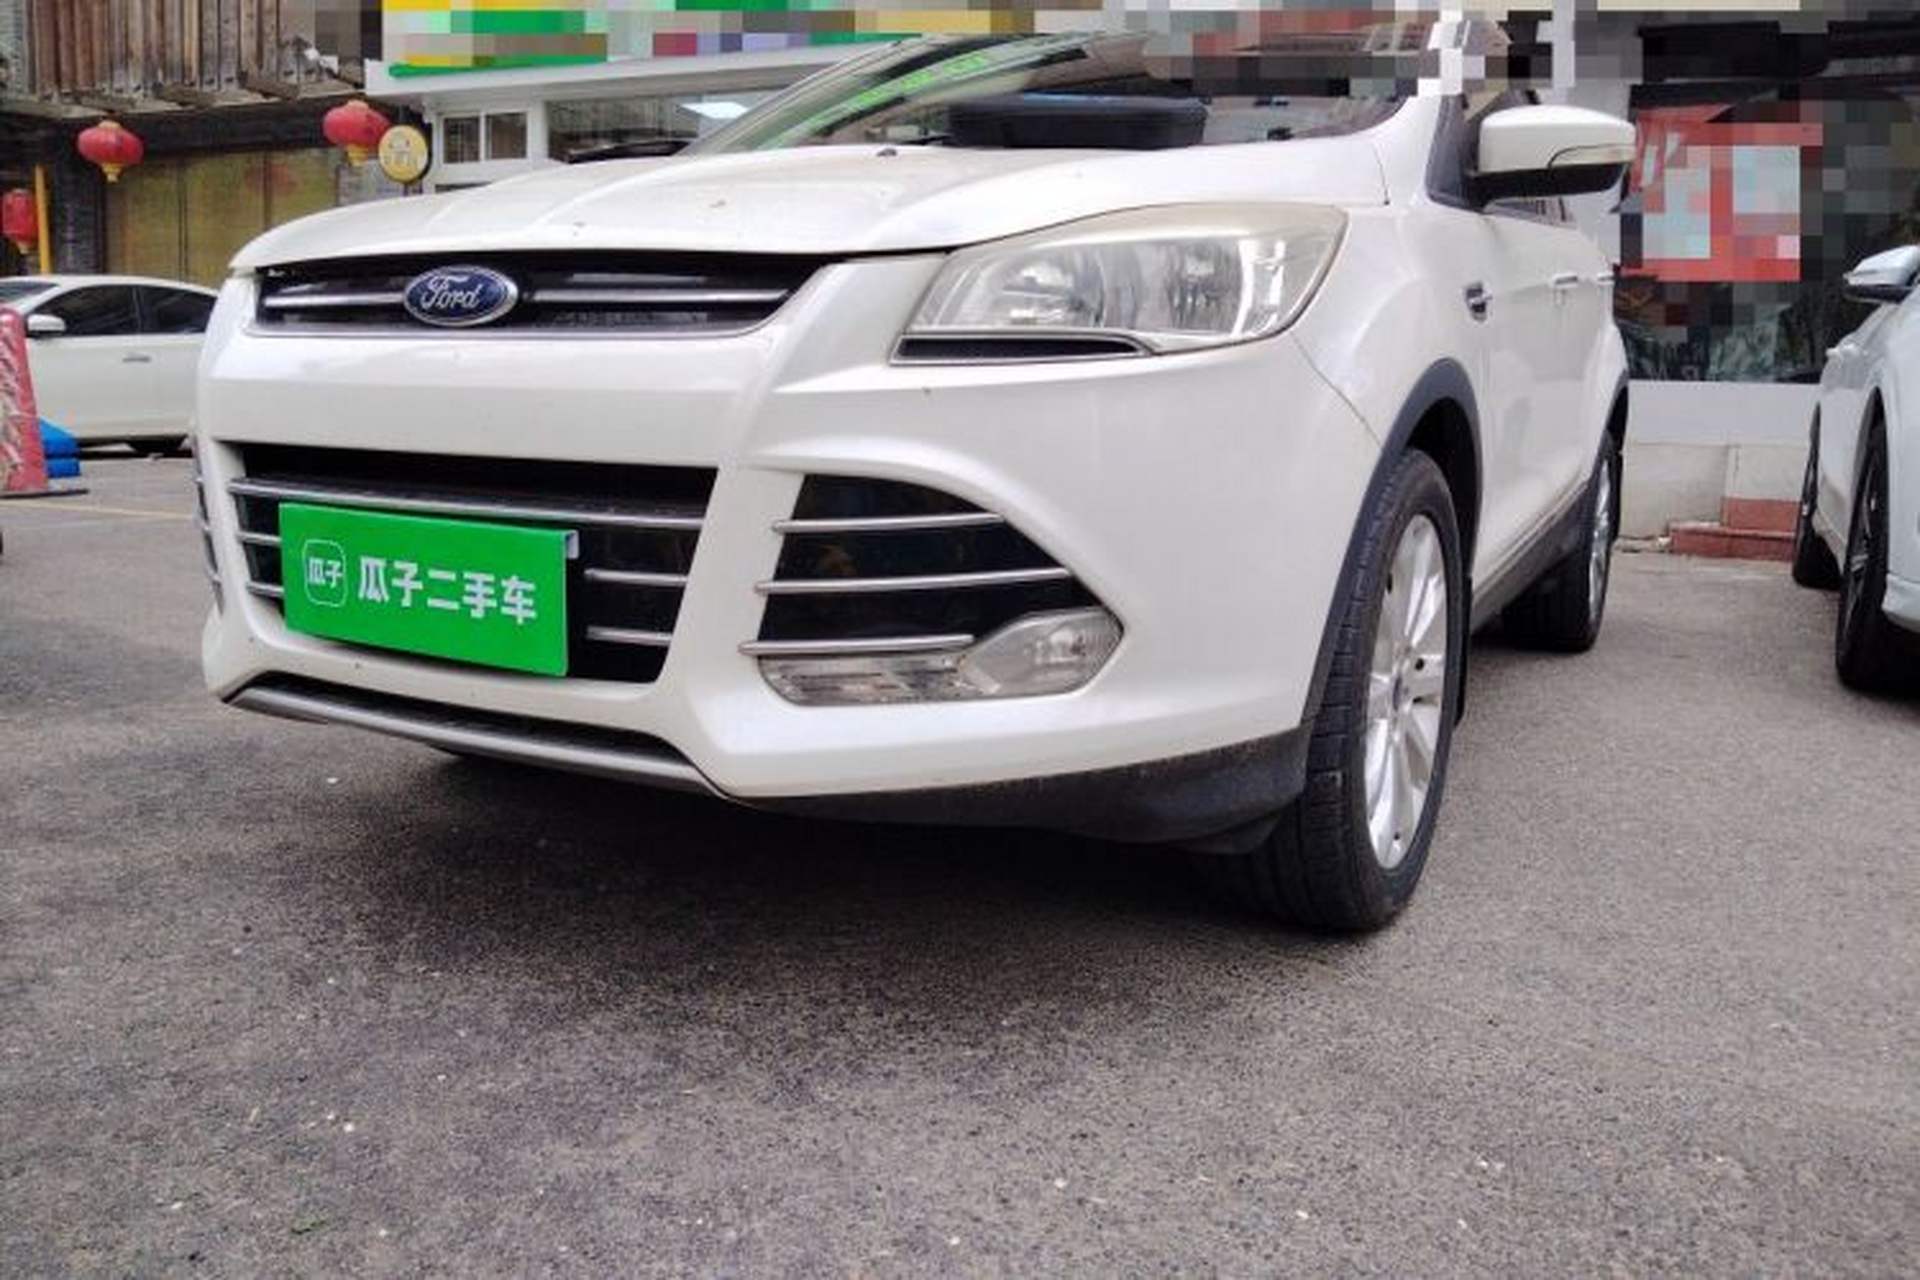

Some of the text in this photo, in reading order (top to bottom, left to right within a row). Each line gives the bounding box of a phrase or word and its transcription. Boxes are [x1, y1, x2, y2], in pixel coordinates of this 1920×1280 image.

[420, 275, 484, 310] Ford
[307, 557, 343, 588] 瓜子
[358, 556, 537, 625] 瓜子二手车
